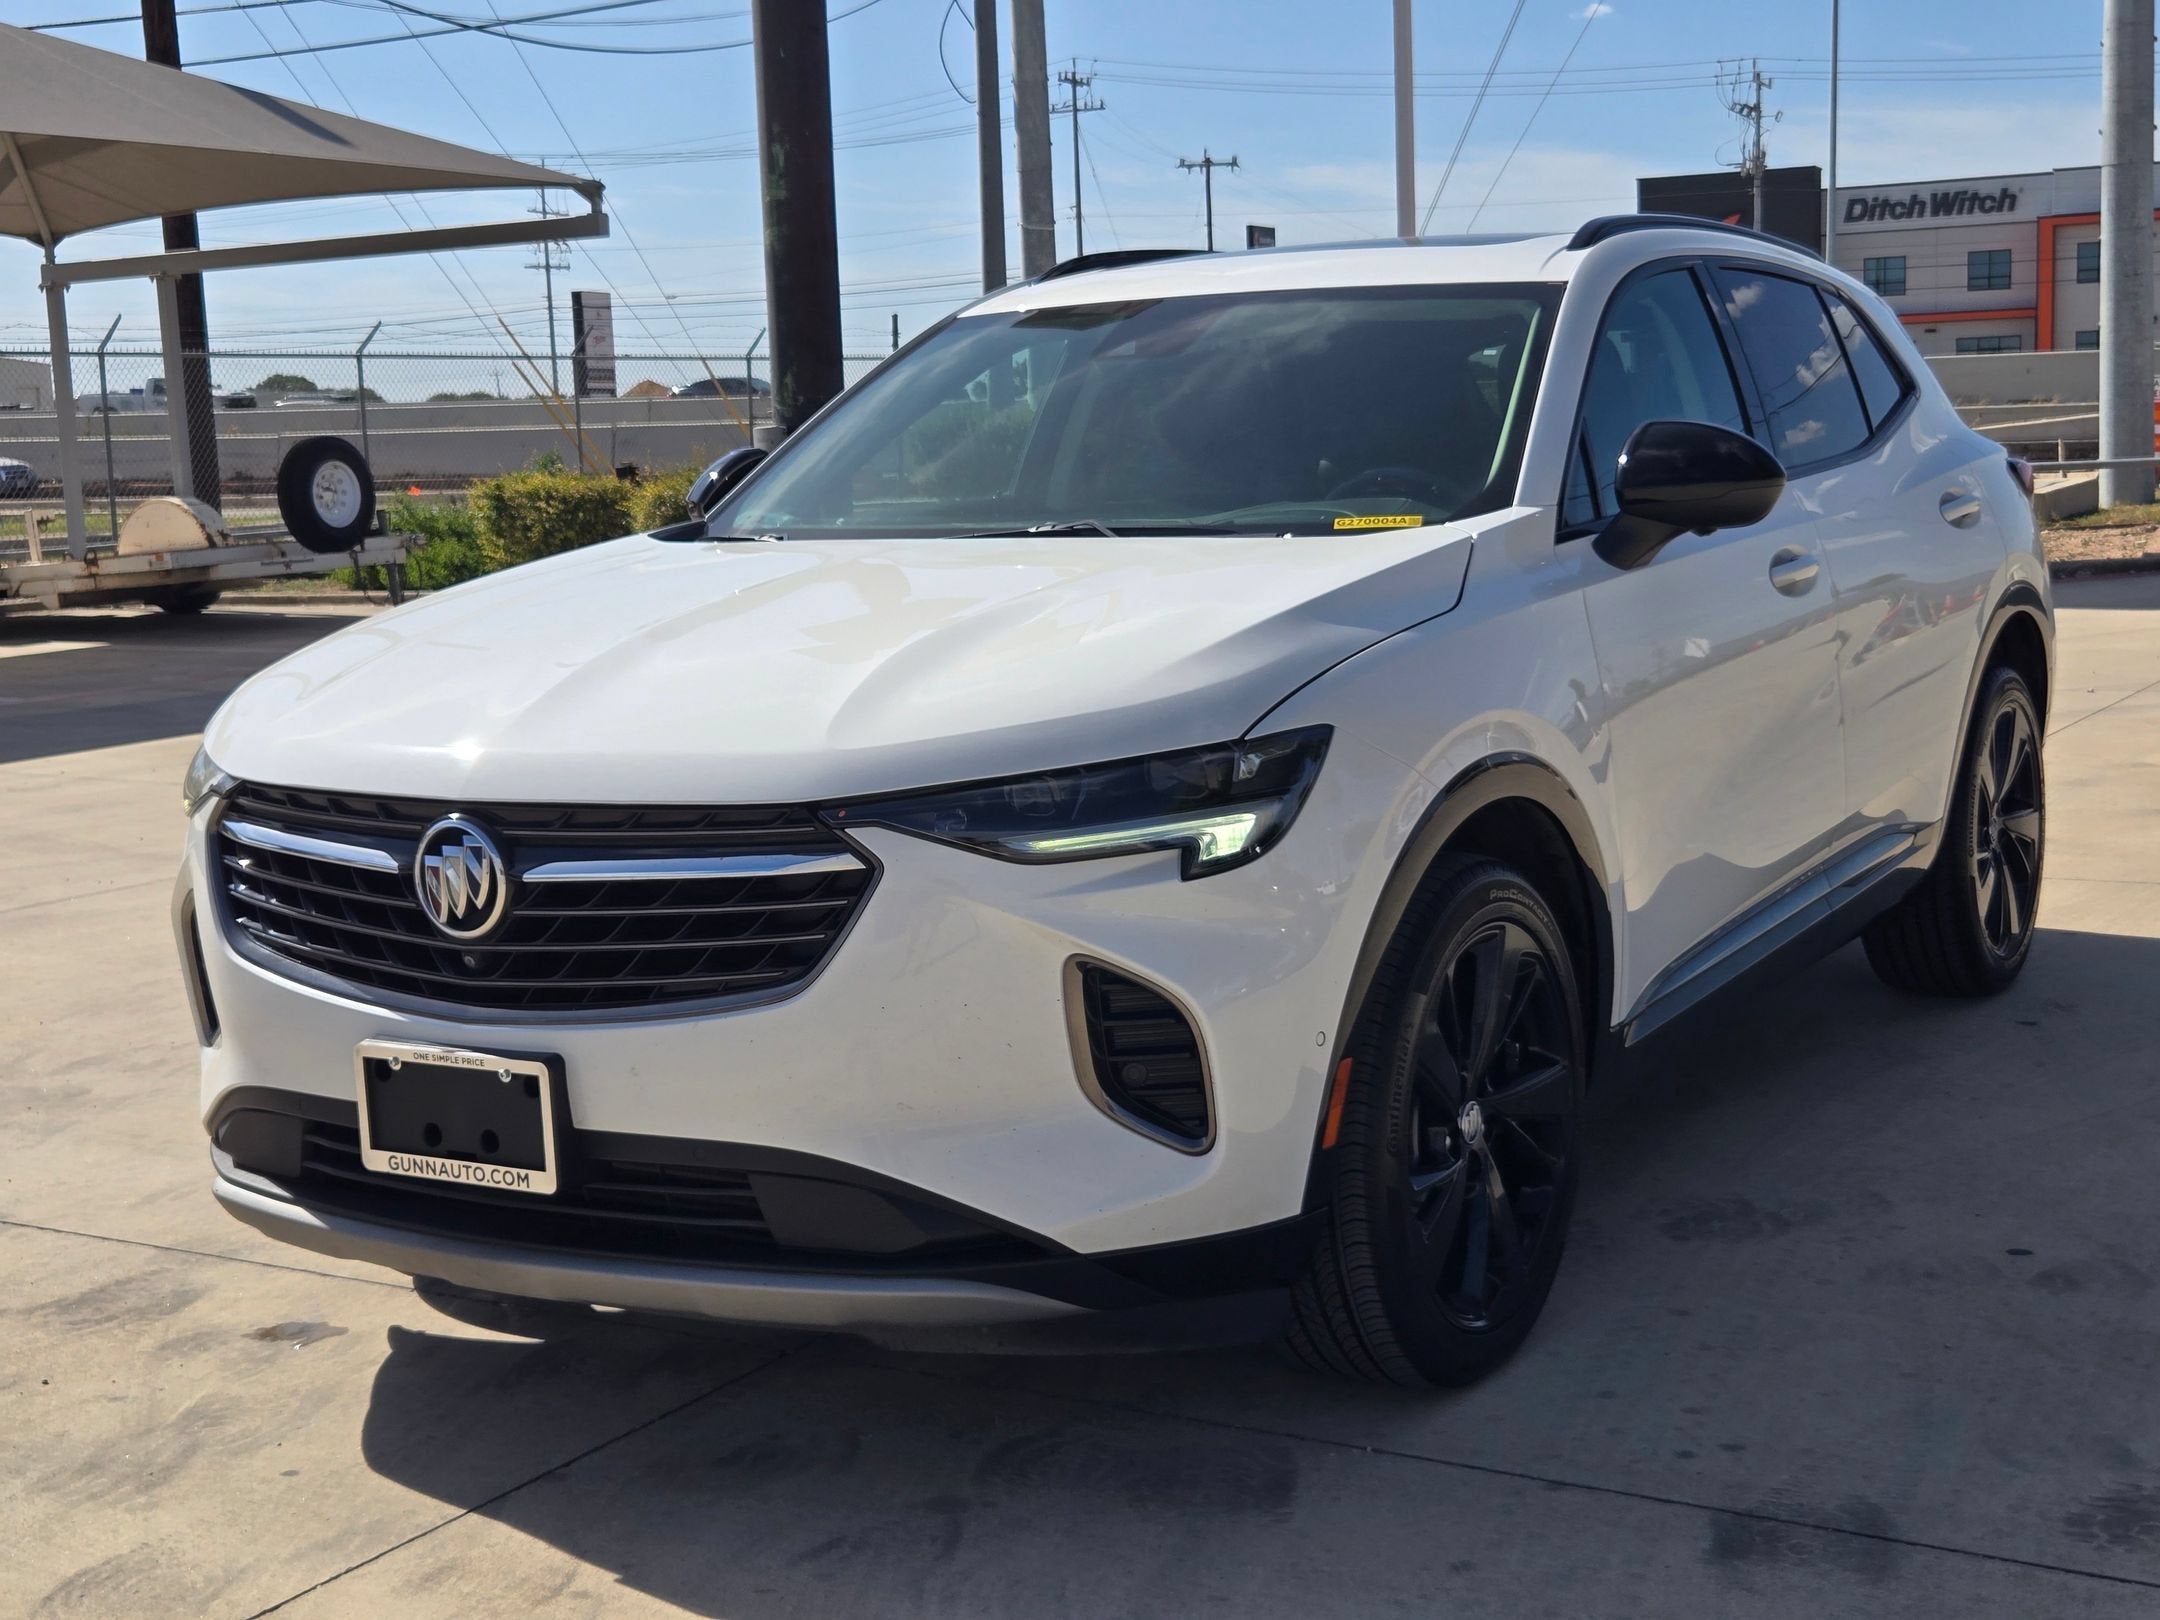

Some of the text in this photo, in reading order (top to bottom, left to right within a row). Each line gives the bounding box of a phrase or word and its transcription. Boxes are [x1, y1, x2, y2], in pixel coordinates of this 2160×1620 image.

[1843, 187, 2019, 223] Ditch Witch
[1336, 517, 1408, 527] G270004A
[413, 1052, 485, 1067] ONE SIMPLE PRICE
[388, 1155, 531, 1189] GUNNAUTO.COM
